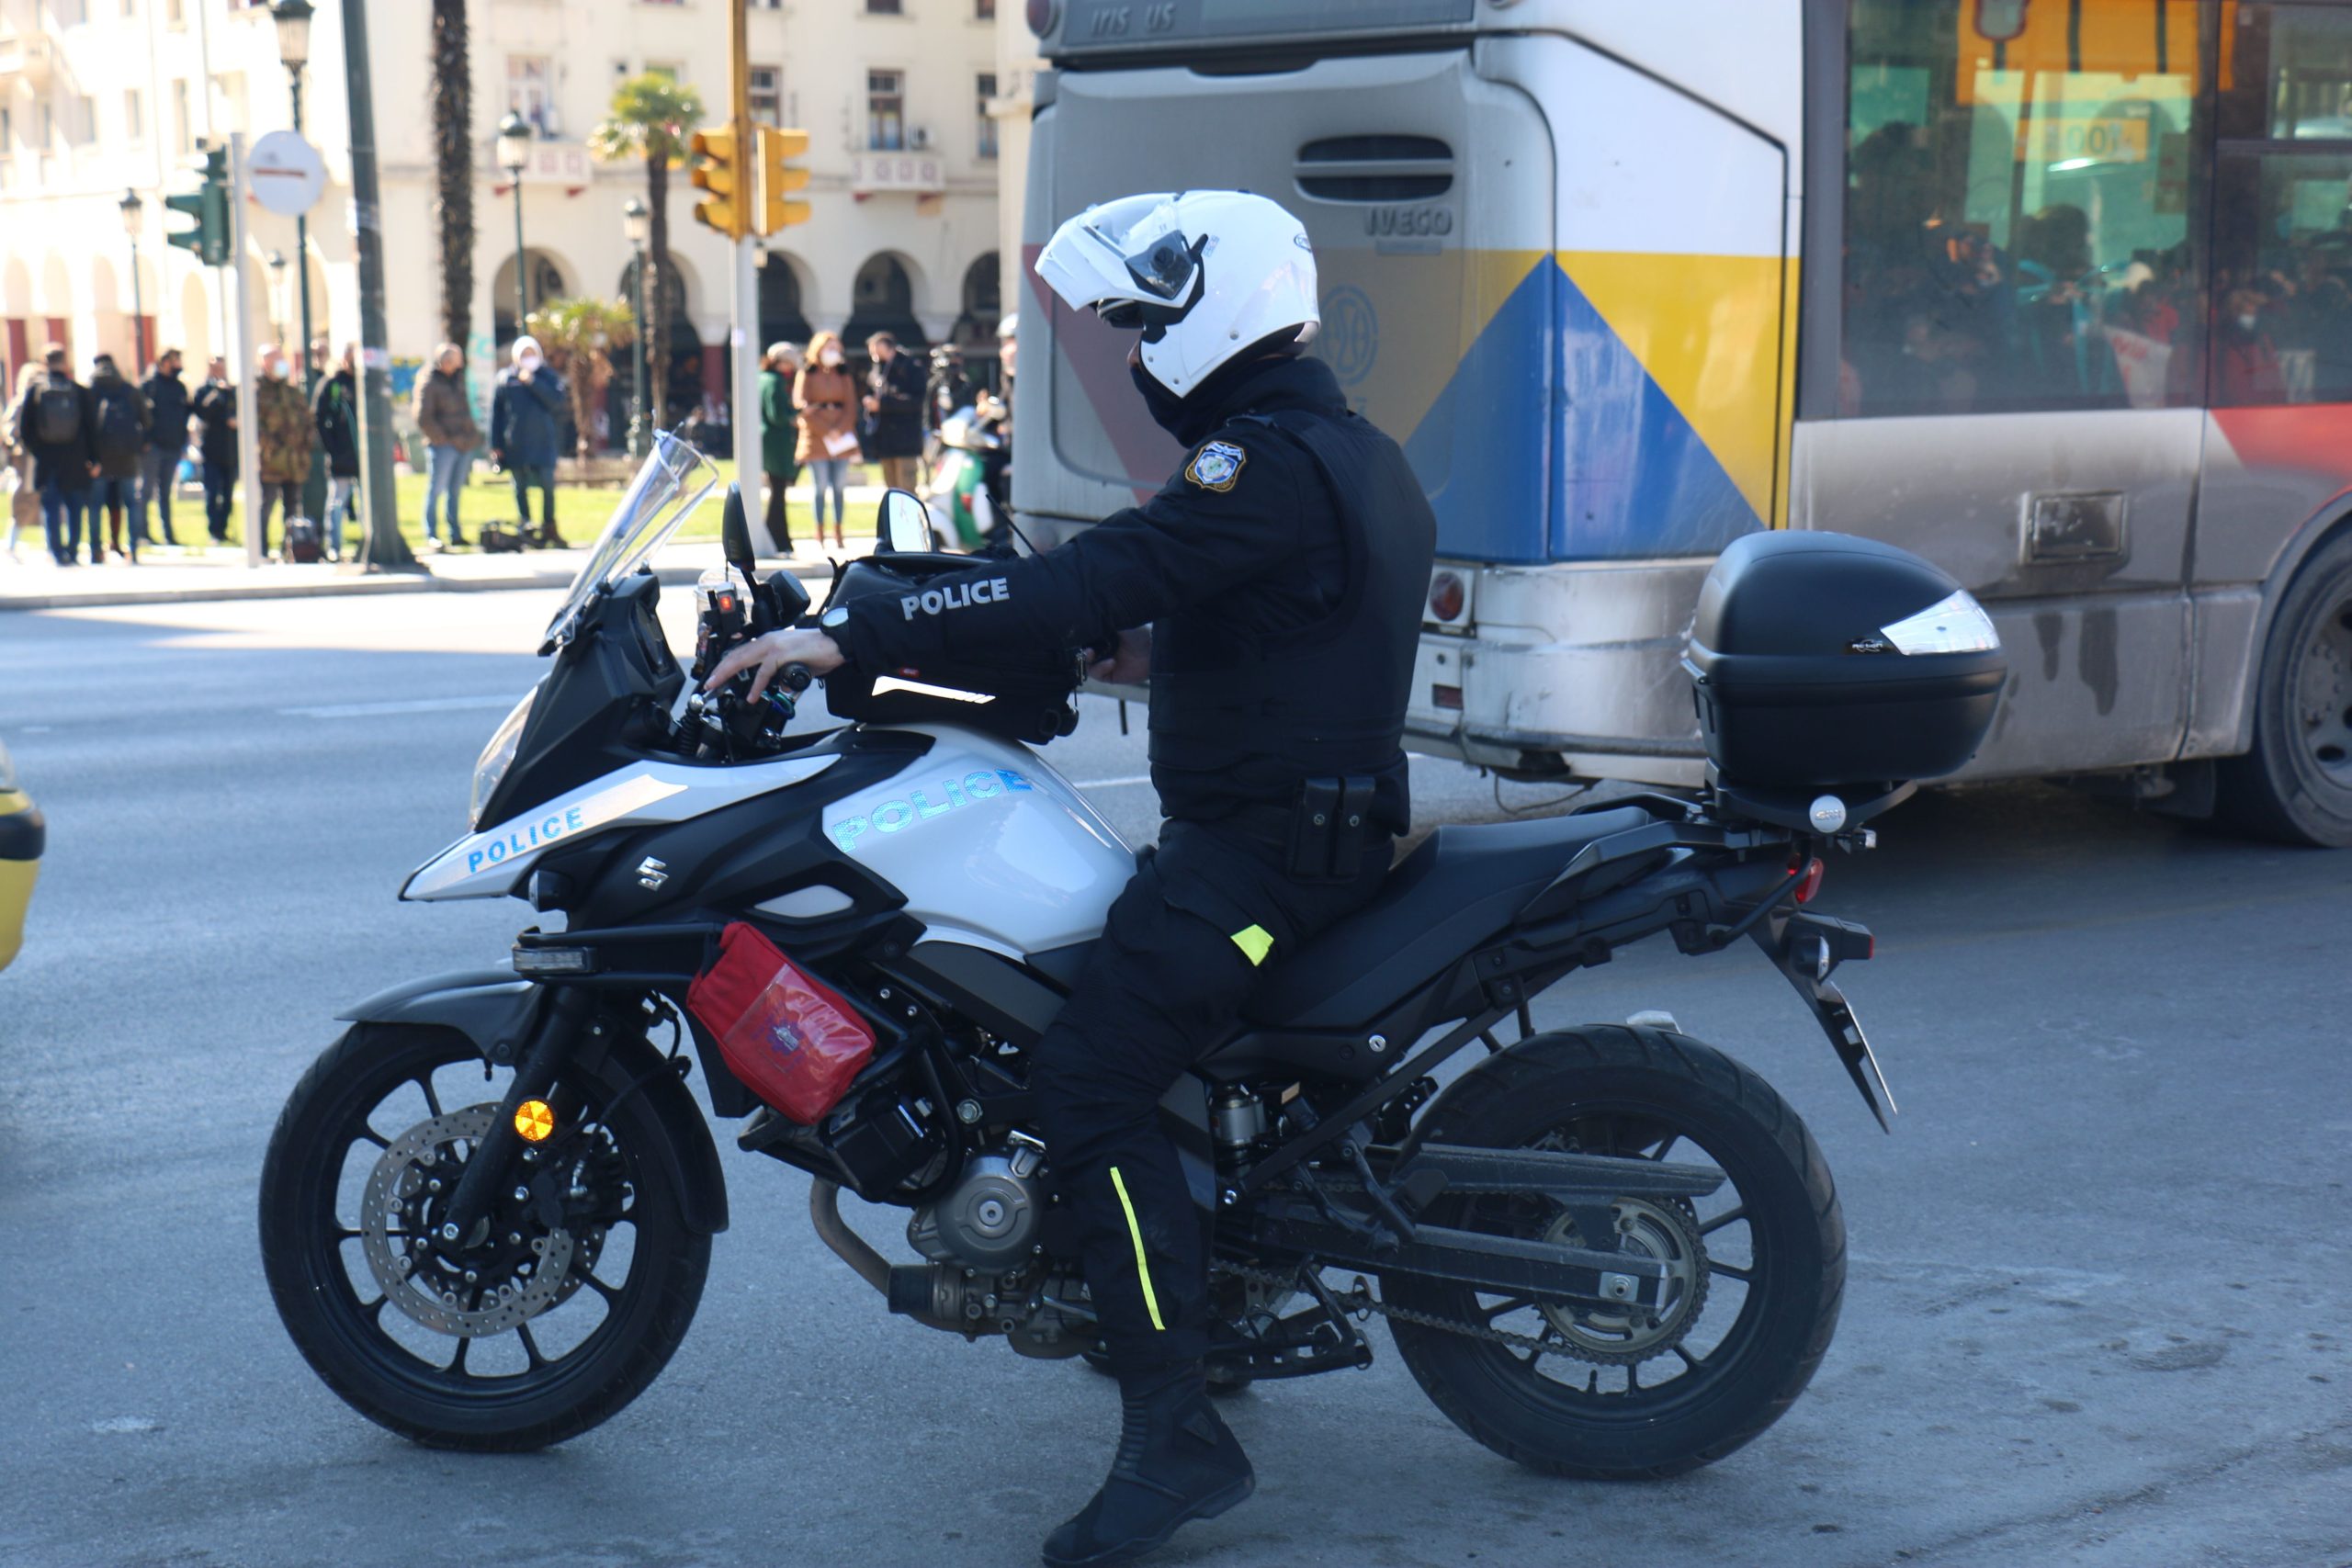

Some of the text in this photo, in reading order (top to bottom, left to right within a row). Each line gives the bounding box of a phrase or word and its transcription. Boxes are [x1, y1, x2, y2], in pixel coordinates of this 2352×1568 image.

[1363, 206, 1453, 237] IVECO
[899, 577, 1011, 621] POLICE
[831, 768, 1034, 852] POLICE
[468, 807, 584, 874] POLICE
